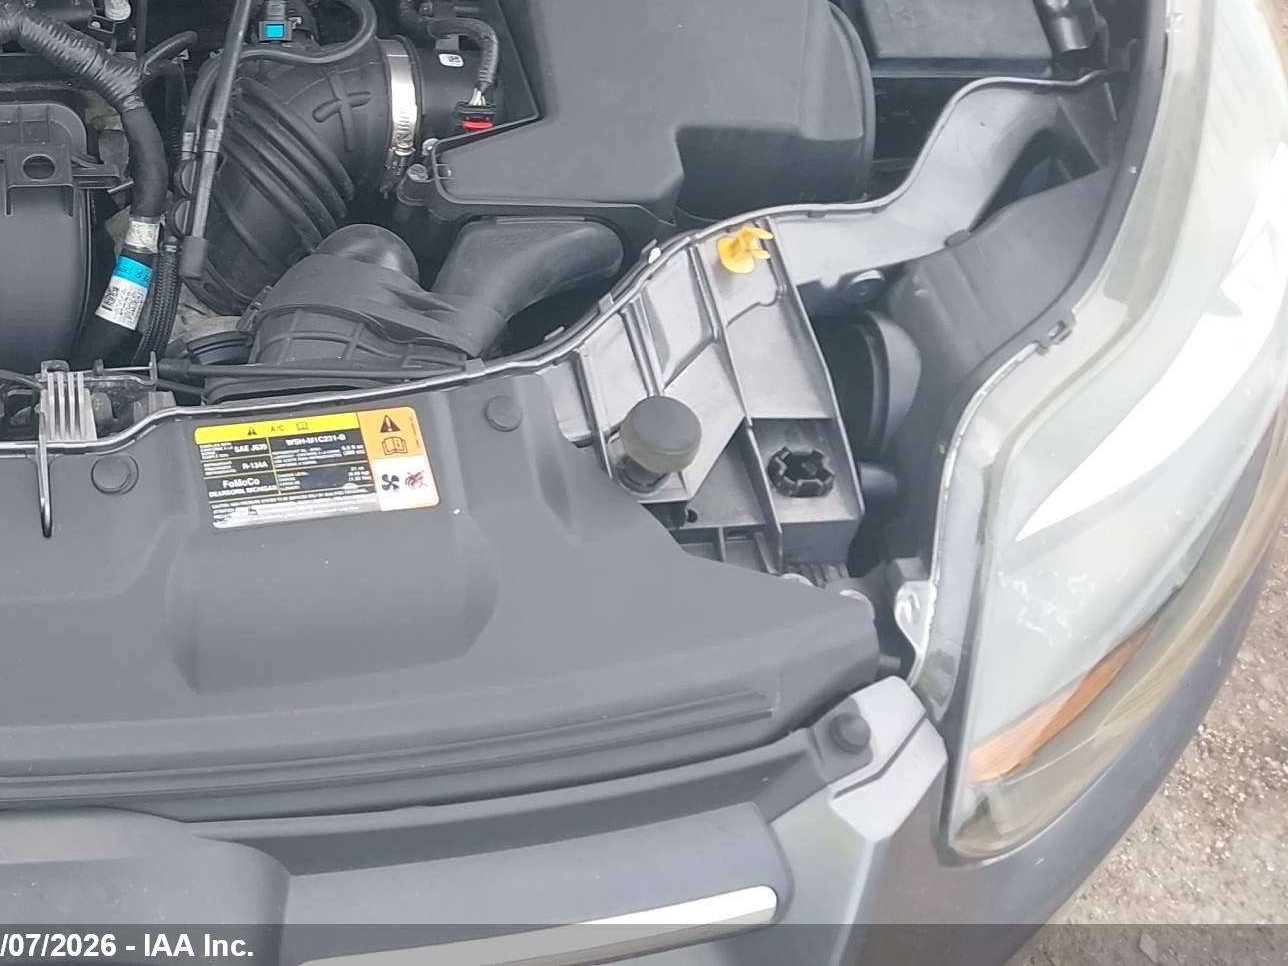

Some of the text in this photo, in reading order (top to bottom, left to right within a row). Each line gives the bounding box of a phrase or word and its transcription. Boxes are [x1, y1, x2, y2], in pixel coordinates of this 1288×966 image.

[270, 424, 285, 433] A/C
[242, 461, 269, 470] R-134A
[222, 477, 260, 489] FoMoCo
